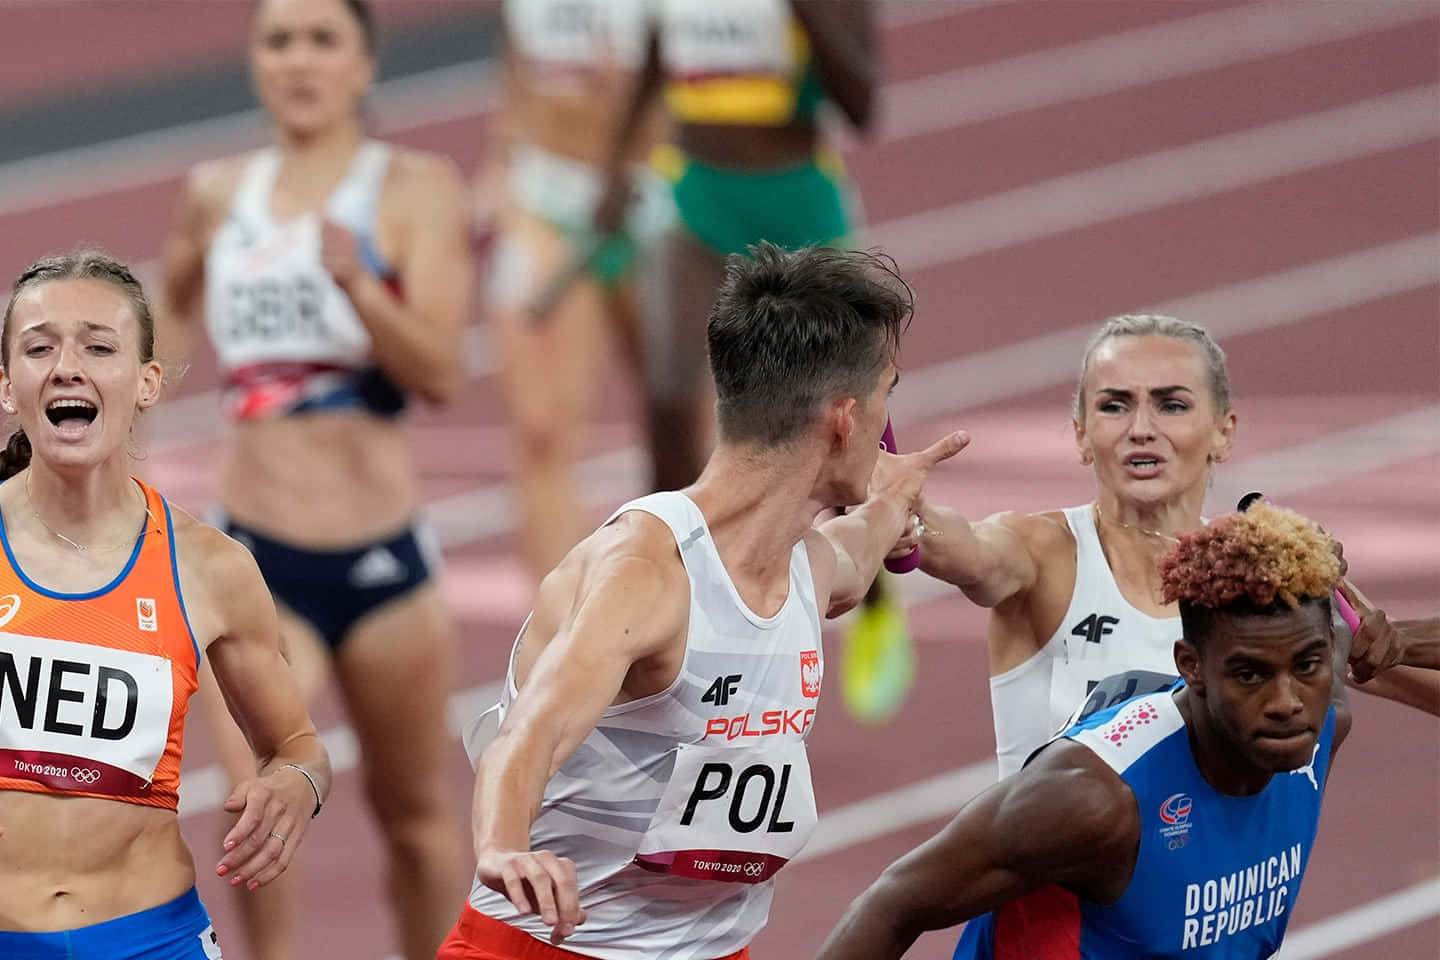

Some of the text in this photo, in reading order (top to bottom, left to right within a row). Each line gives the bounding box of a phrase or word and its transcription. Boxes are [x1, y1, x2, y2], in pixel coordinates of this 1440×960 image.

[1071, 613, 1120, 644] 4F
[701, 674, 742, 706] 4F
[14, 759, 68, 777] TOKYO 2020
[680, 762, 795, 834] POL
[693, 860, 742, 873] TOKYO 2020
[1184, 843, 1301, 917] DOMINICAN
[1182, 885, 1288, 950] REPUBLIC
